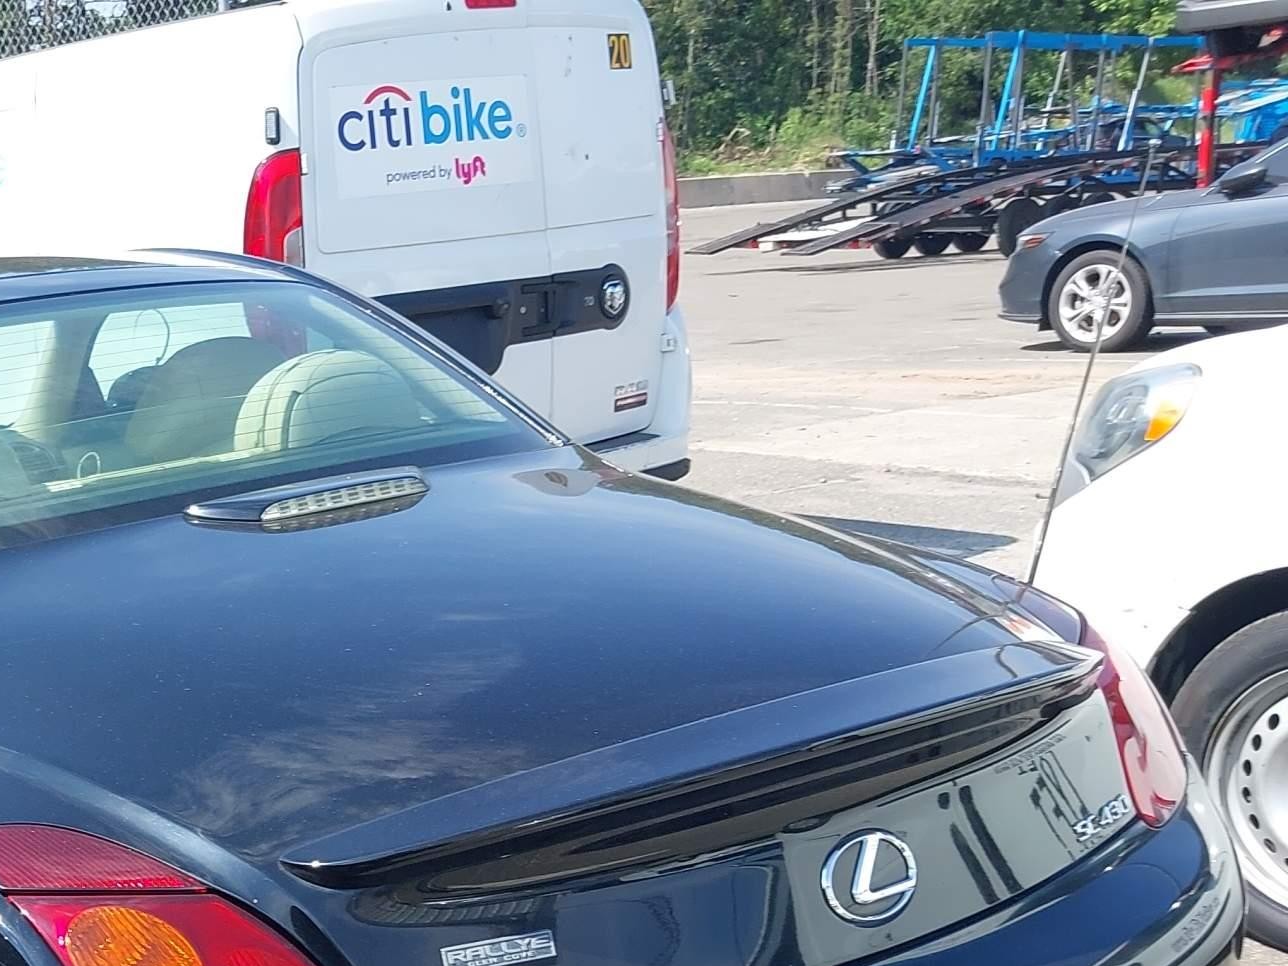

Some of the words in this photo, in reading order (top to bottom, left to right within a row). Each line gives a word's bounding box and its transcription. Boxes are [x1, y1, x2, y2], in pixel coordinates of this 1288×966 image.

[608, 34, 630, 68] 20
[337, 86, 413, 152] citi
[419, 86, 513, 145] bike
[386, 165, 436, 186] powered
[438, 164, 452, 180] by
[454, 156, 486, 185] lyft
[447, 934, 552, 965] RALLYE
[503, 950, 537, 961] COVE
